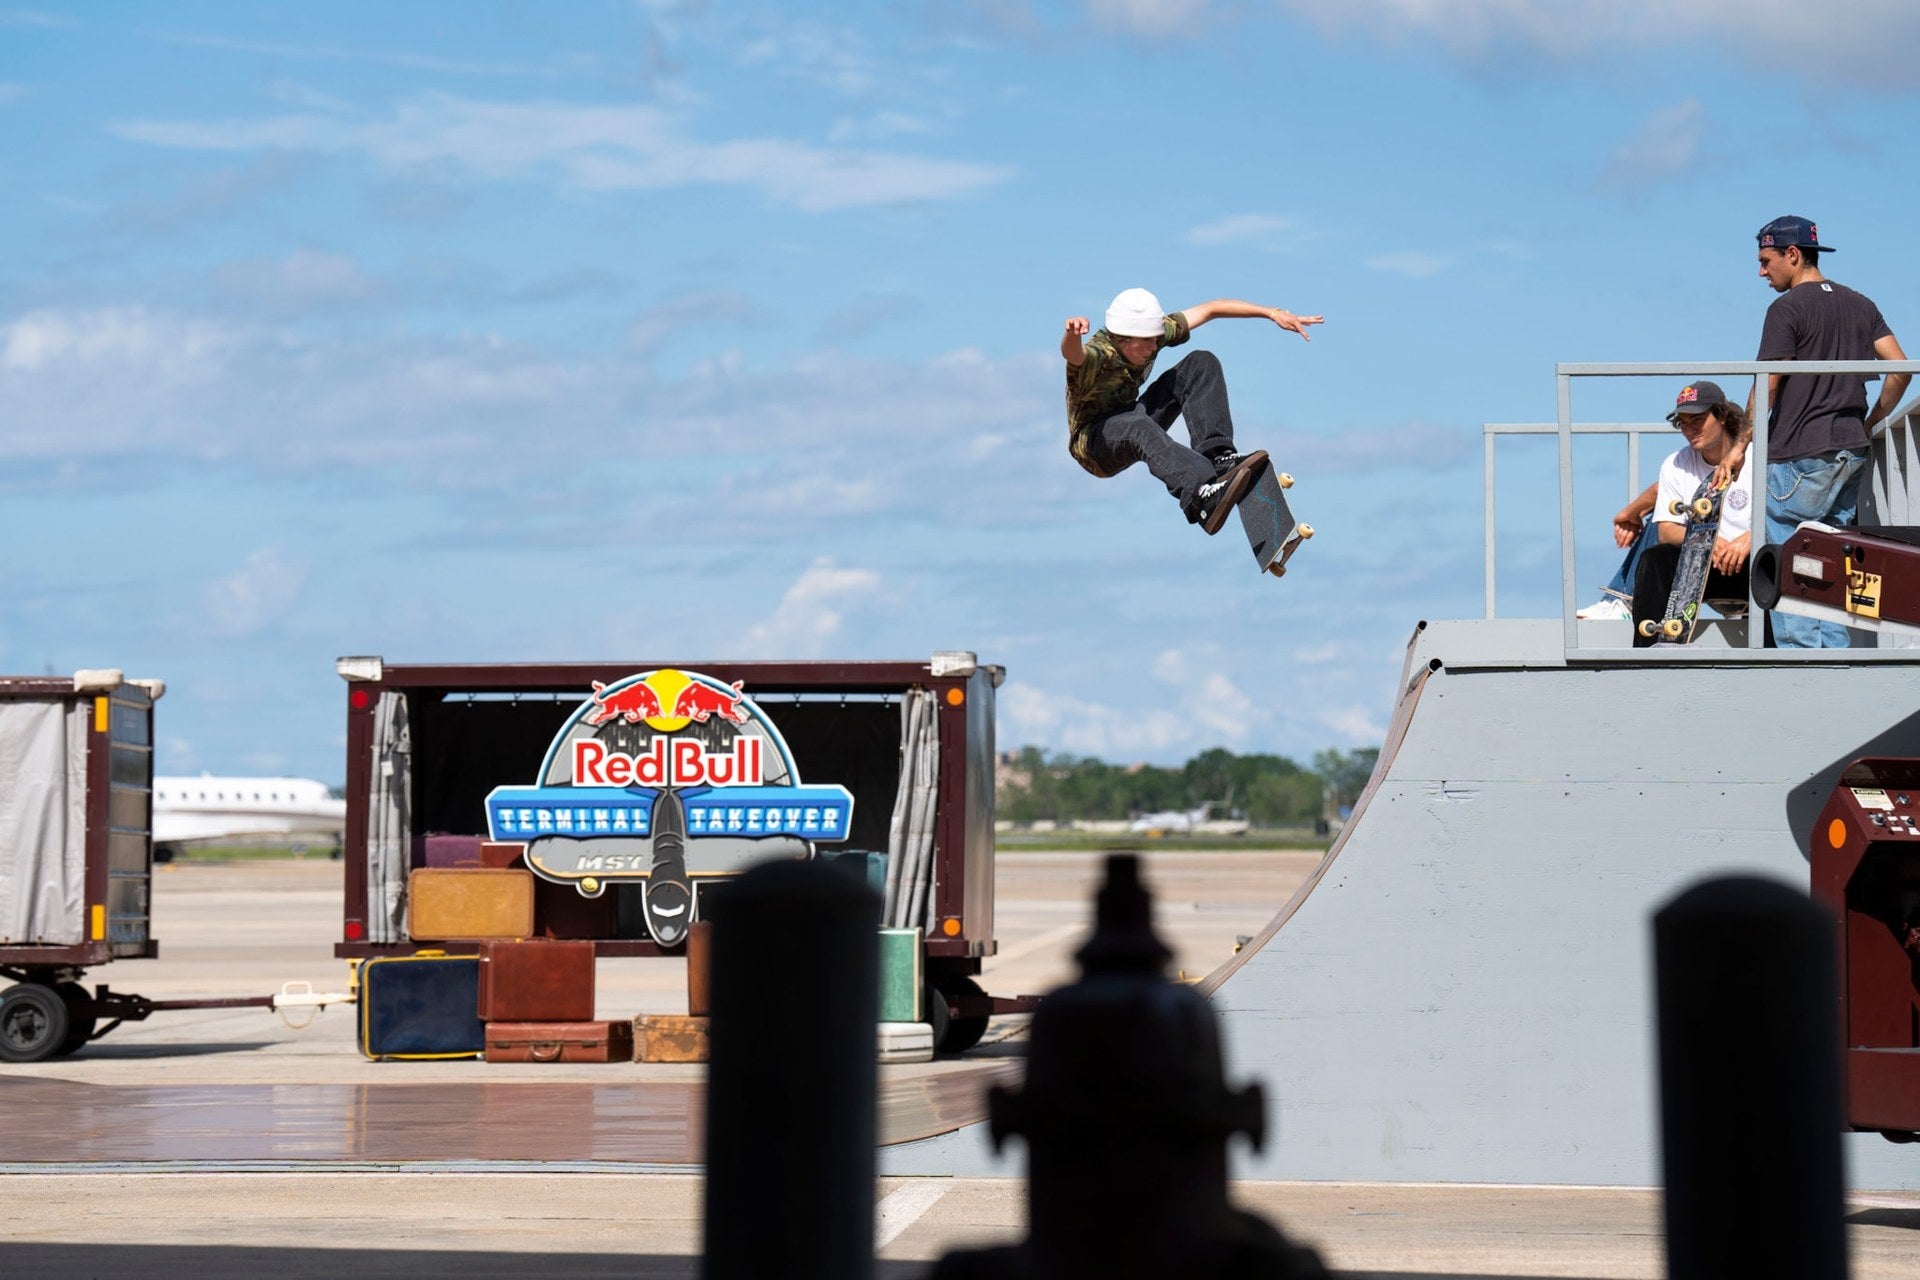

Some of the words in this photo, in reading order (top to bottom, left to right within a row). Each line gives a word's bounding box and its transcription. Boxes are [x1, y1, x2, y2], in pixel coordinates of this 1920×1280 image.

[576, 739, 664, 784] Red
[675, 739, 760, 784] Bull
[499, 808, 648, 830] TERMINAL
[692, 807, 838, 829] TAKEOVER
[576, 855, 643, 870] MSY
